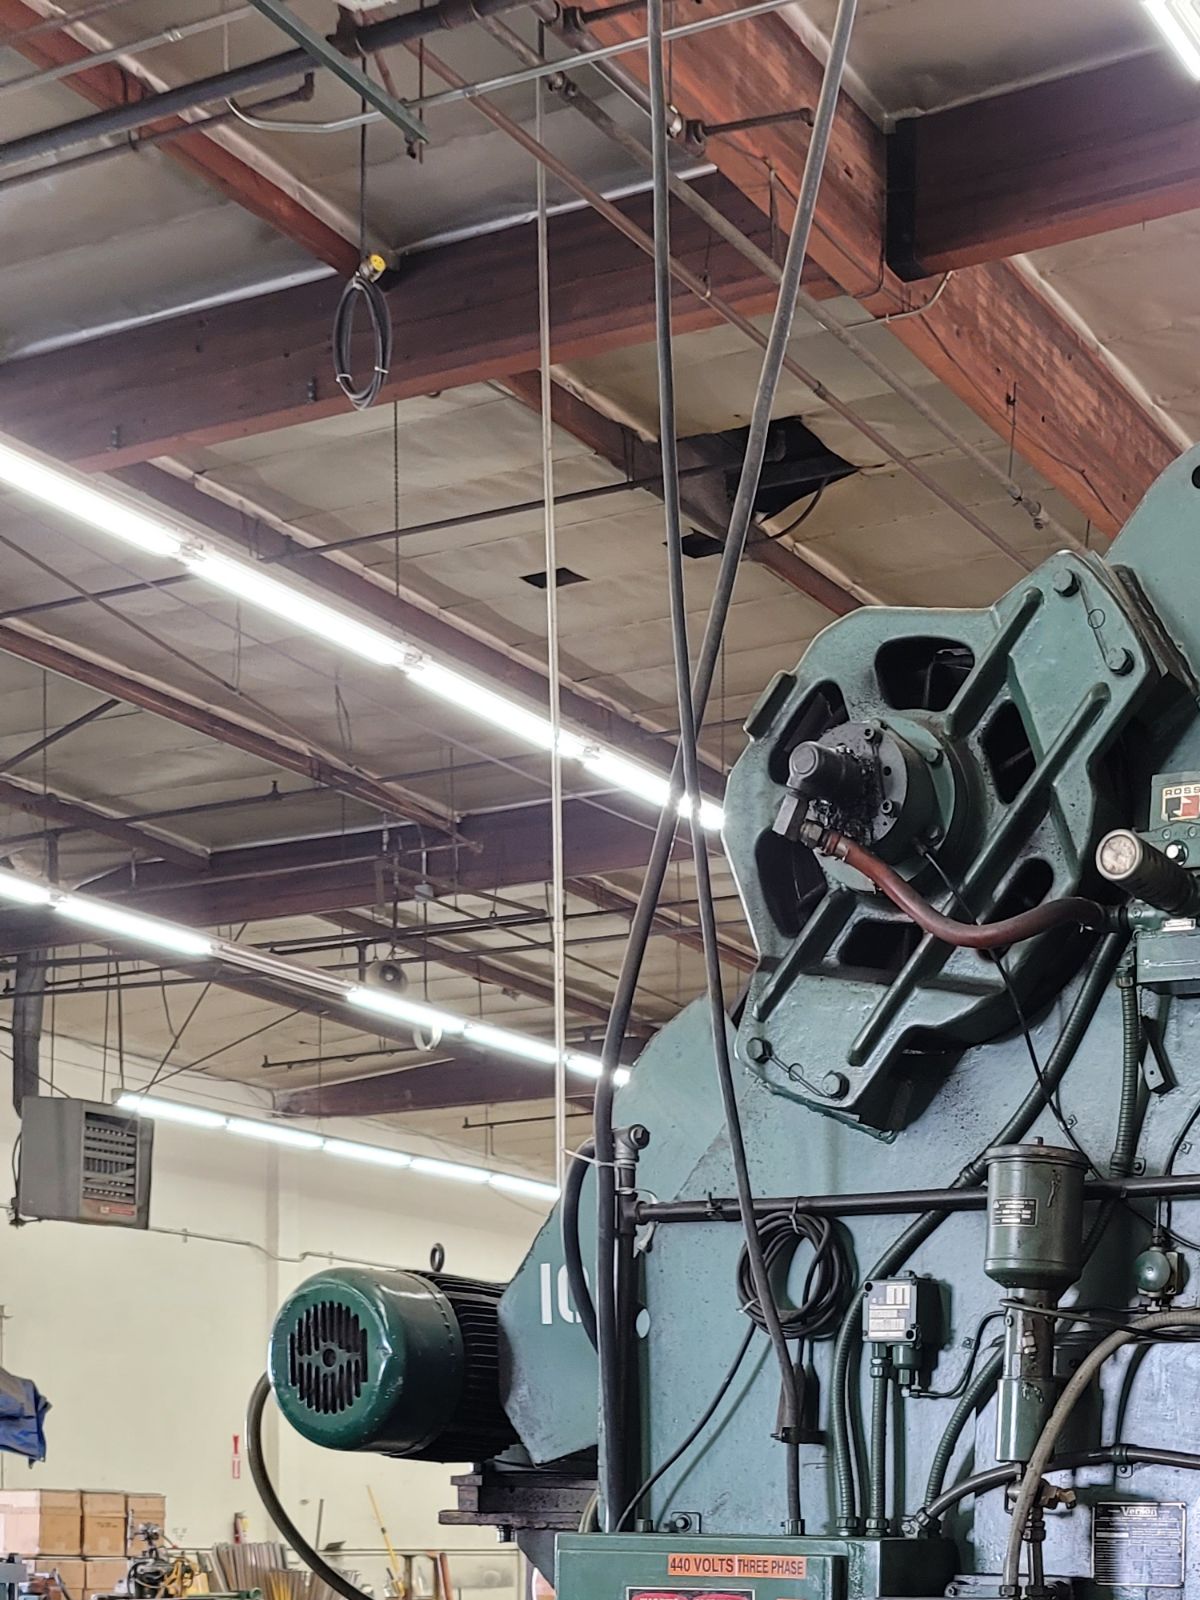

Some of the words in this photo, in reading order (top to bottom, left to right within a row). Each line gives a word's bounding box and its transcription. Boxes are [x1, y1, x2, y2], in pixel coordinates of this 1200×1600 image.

[1165, 786, 1200, 796] ROSS
[1121, 1506, 1158, 1516] Verson
[670, 1557, 690, 1571] 440
[694, 1558, 734, 1572] VOLTS
[737, 1559, 769, 1573] THREE
[771, 1560, 803, 1574] PHASE
